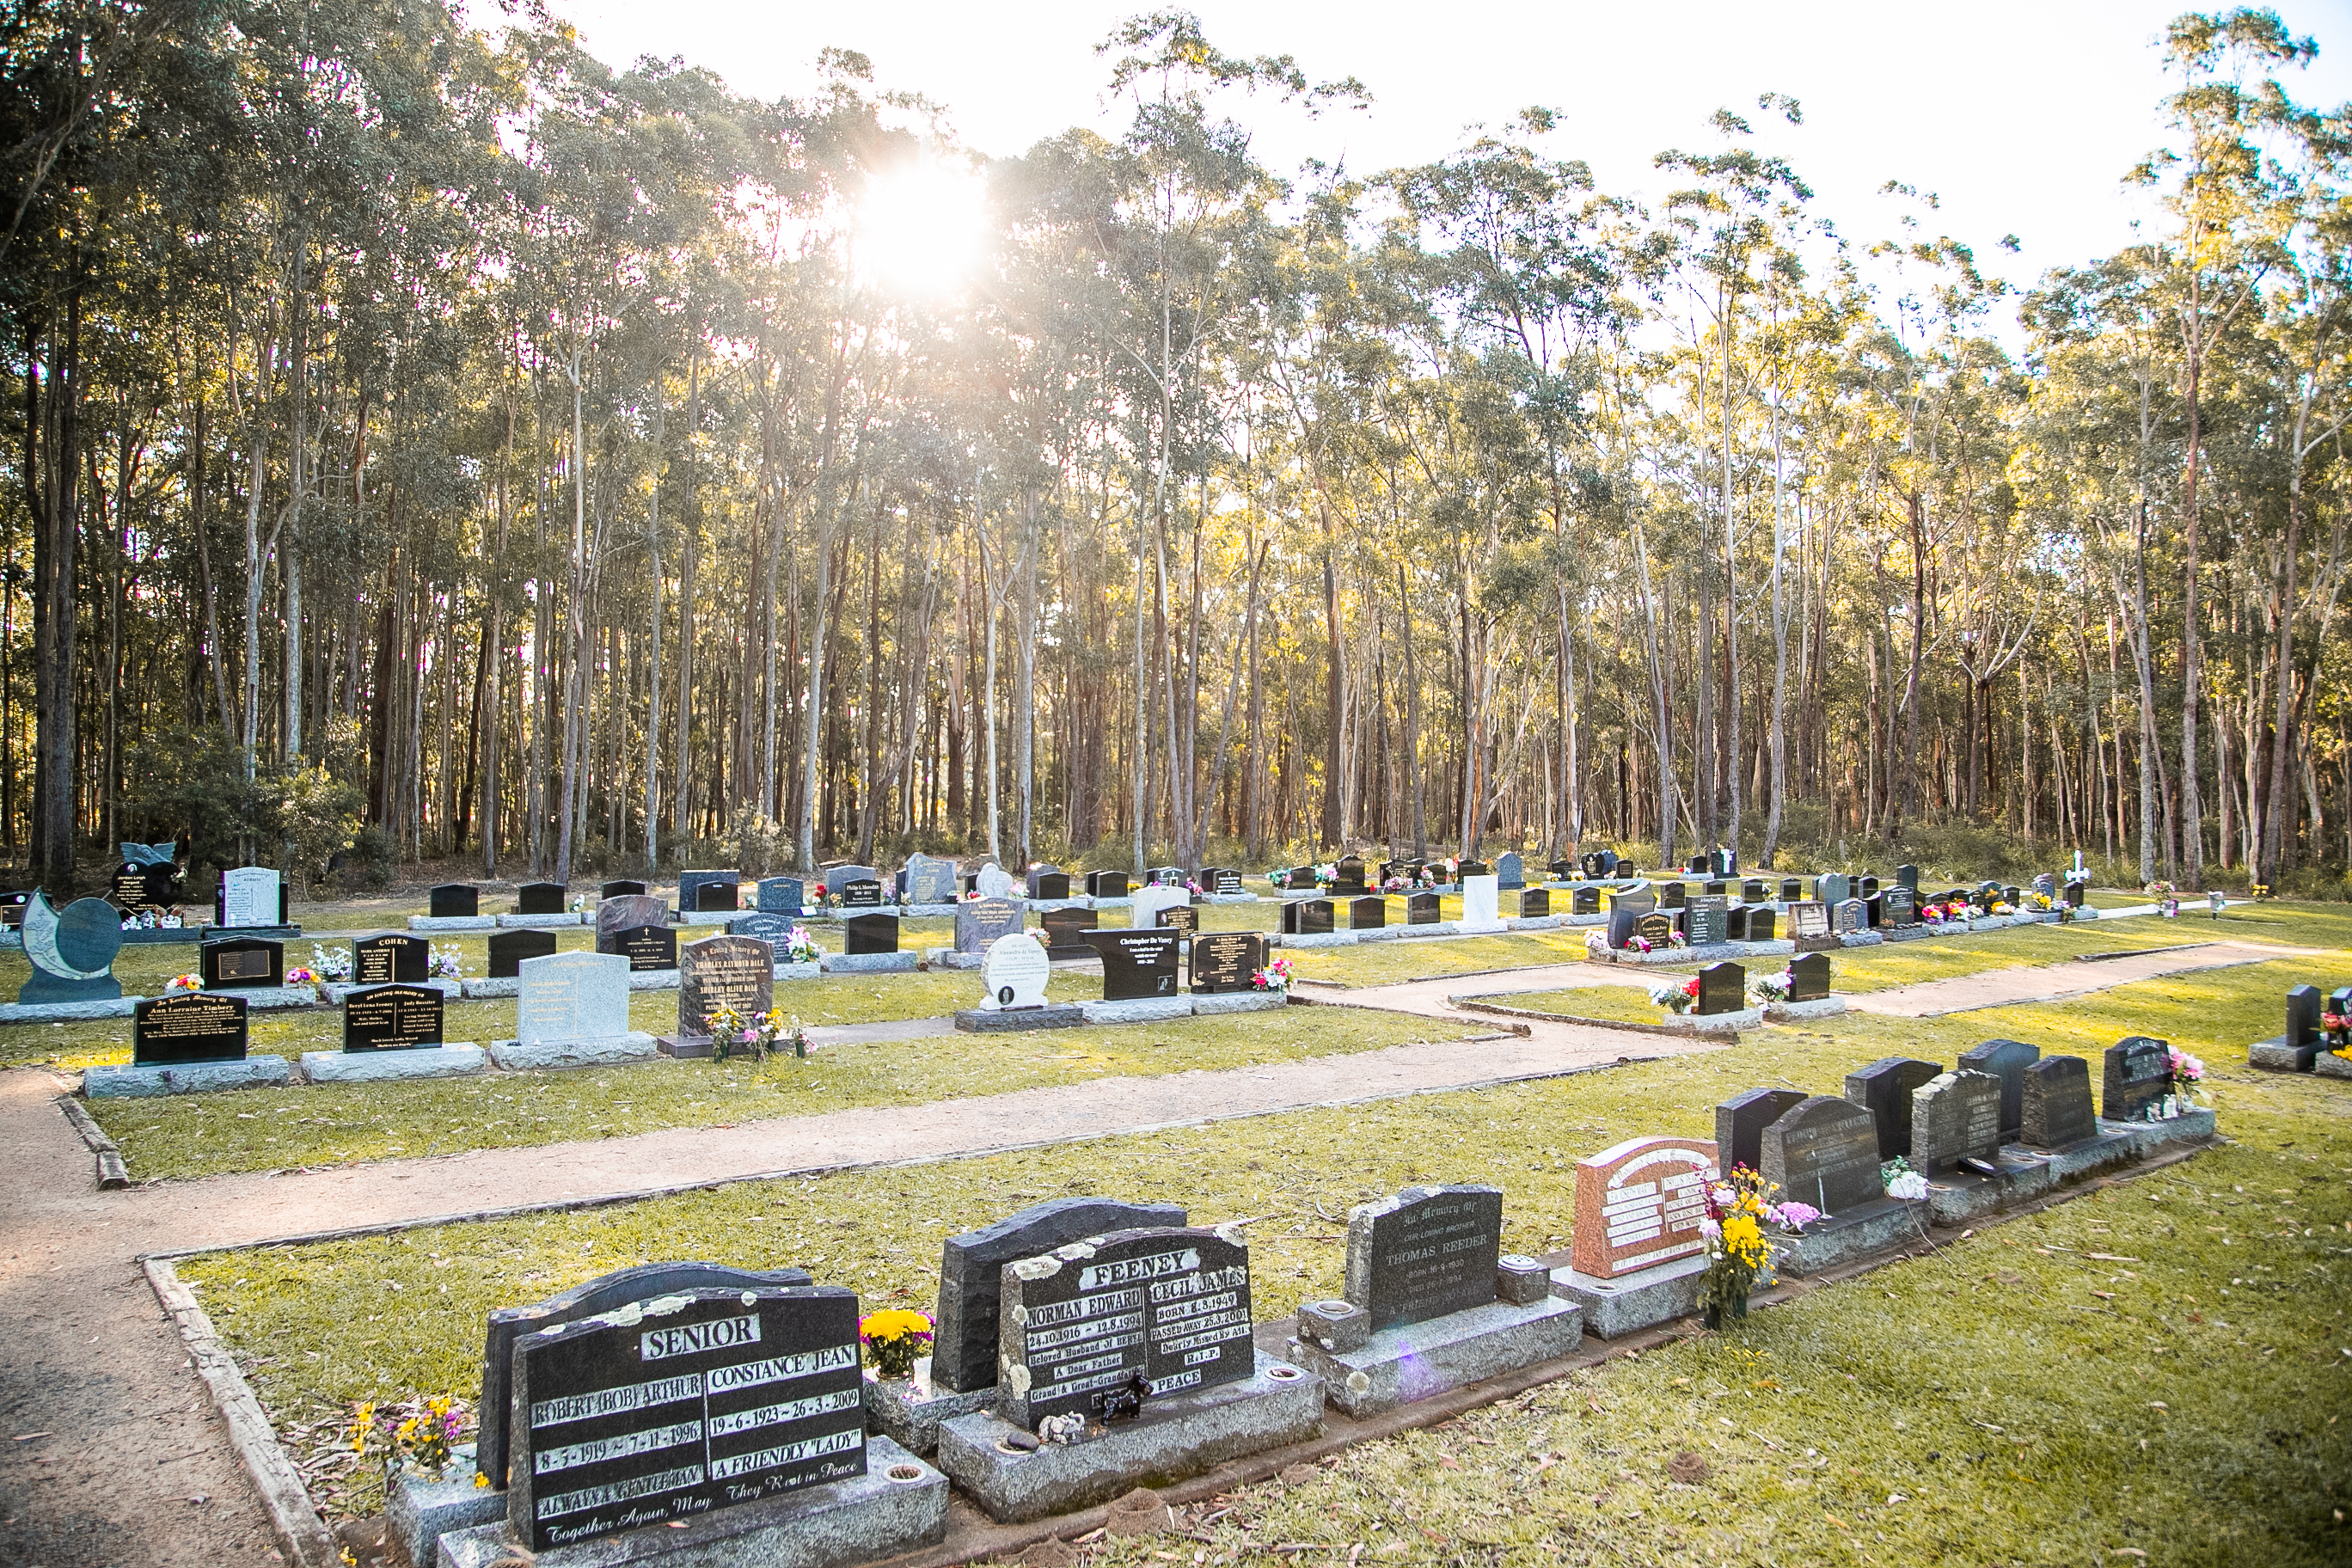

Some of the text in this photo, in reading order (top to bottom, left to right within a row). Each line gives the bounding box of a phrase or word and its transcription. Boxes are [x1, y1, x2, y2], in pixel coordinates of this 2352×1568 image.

[1119, 937, 1150, 946] Christopher
[695, 959, 765, 969] CHARLES RAYMOND DALE
[700, 985, 725, 995] SHIRLEY
[726, 984, 743, 993] OLIVE
[1638, 1182, 1657, 1197] MARTIN
[1404, 1216, 1418, 1228] In
[1421, 1204, 1459, 1221] Memory
[1404, 1221, 1475, 1242] OUR LOVING BROTHER
[1386, 1234, 1487, 1266] THOMAS REEDER
[1095, 1251, 1185, 1286] FEENEY
[1409, 1268, 1427, 1278] BORN
[1153, 1269, 1246, 1301] CECIL JAMES
[1027, 1289, 1140, 1327] NORMAN EDWARD
[1159, 1306, 1185, 1320] BORN
[650, 1316, 753, 1357] SENIOR
[1030, 1326, 1081, 1347] 24.10.1916
[1098, 1314, 1142, 1332] 12.8.1994
[1152, 1326, 1182, 1341] PASSED
[1184, 1321, 1201, 1334] AWAY
[1162, 1341, 1191, 1353] Dearly
[1193, 1333, 1219, 1346] Missed
[1220, 1331, 1229, 1341] By
[1031, 1351, 1062, 1365] Beloved
[1066, 1342, 1099, 1357] Husband
[1117, 1332, 1142, 1346] BERYL
[1187, 1350, 1219, 1363] R.I.P.
[712, 1345, 853, 1388] CONSTANCE JEAN
[1057, 1356, 1120, 1378] A Dear Father
[1158, 1370, 1200, 1391] PEACE
[534, 1376, 700, 1424] ROBERT (BOB) ARTHUR
[1032, 1387, 1057, 1400] Grand
[1061, 1385, 1067, 1393] &
[716, 1432, 860, 1477] A FRIENDLY "LADY"
[542, 1491, 597, 1518] ALWAYS
[602, 1490, 610, 1503] A
[547, 1461, 858, 1543] Together Again, May They Rest in Peace
